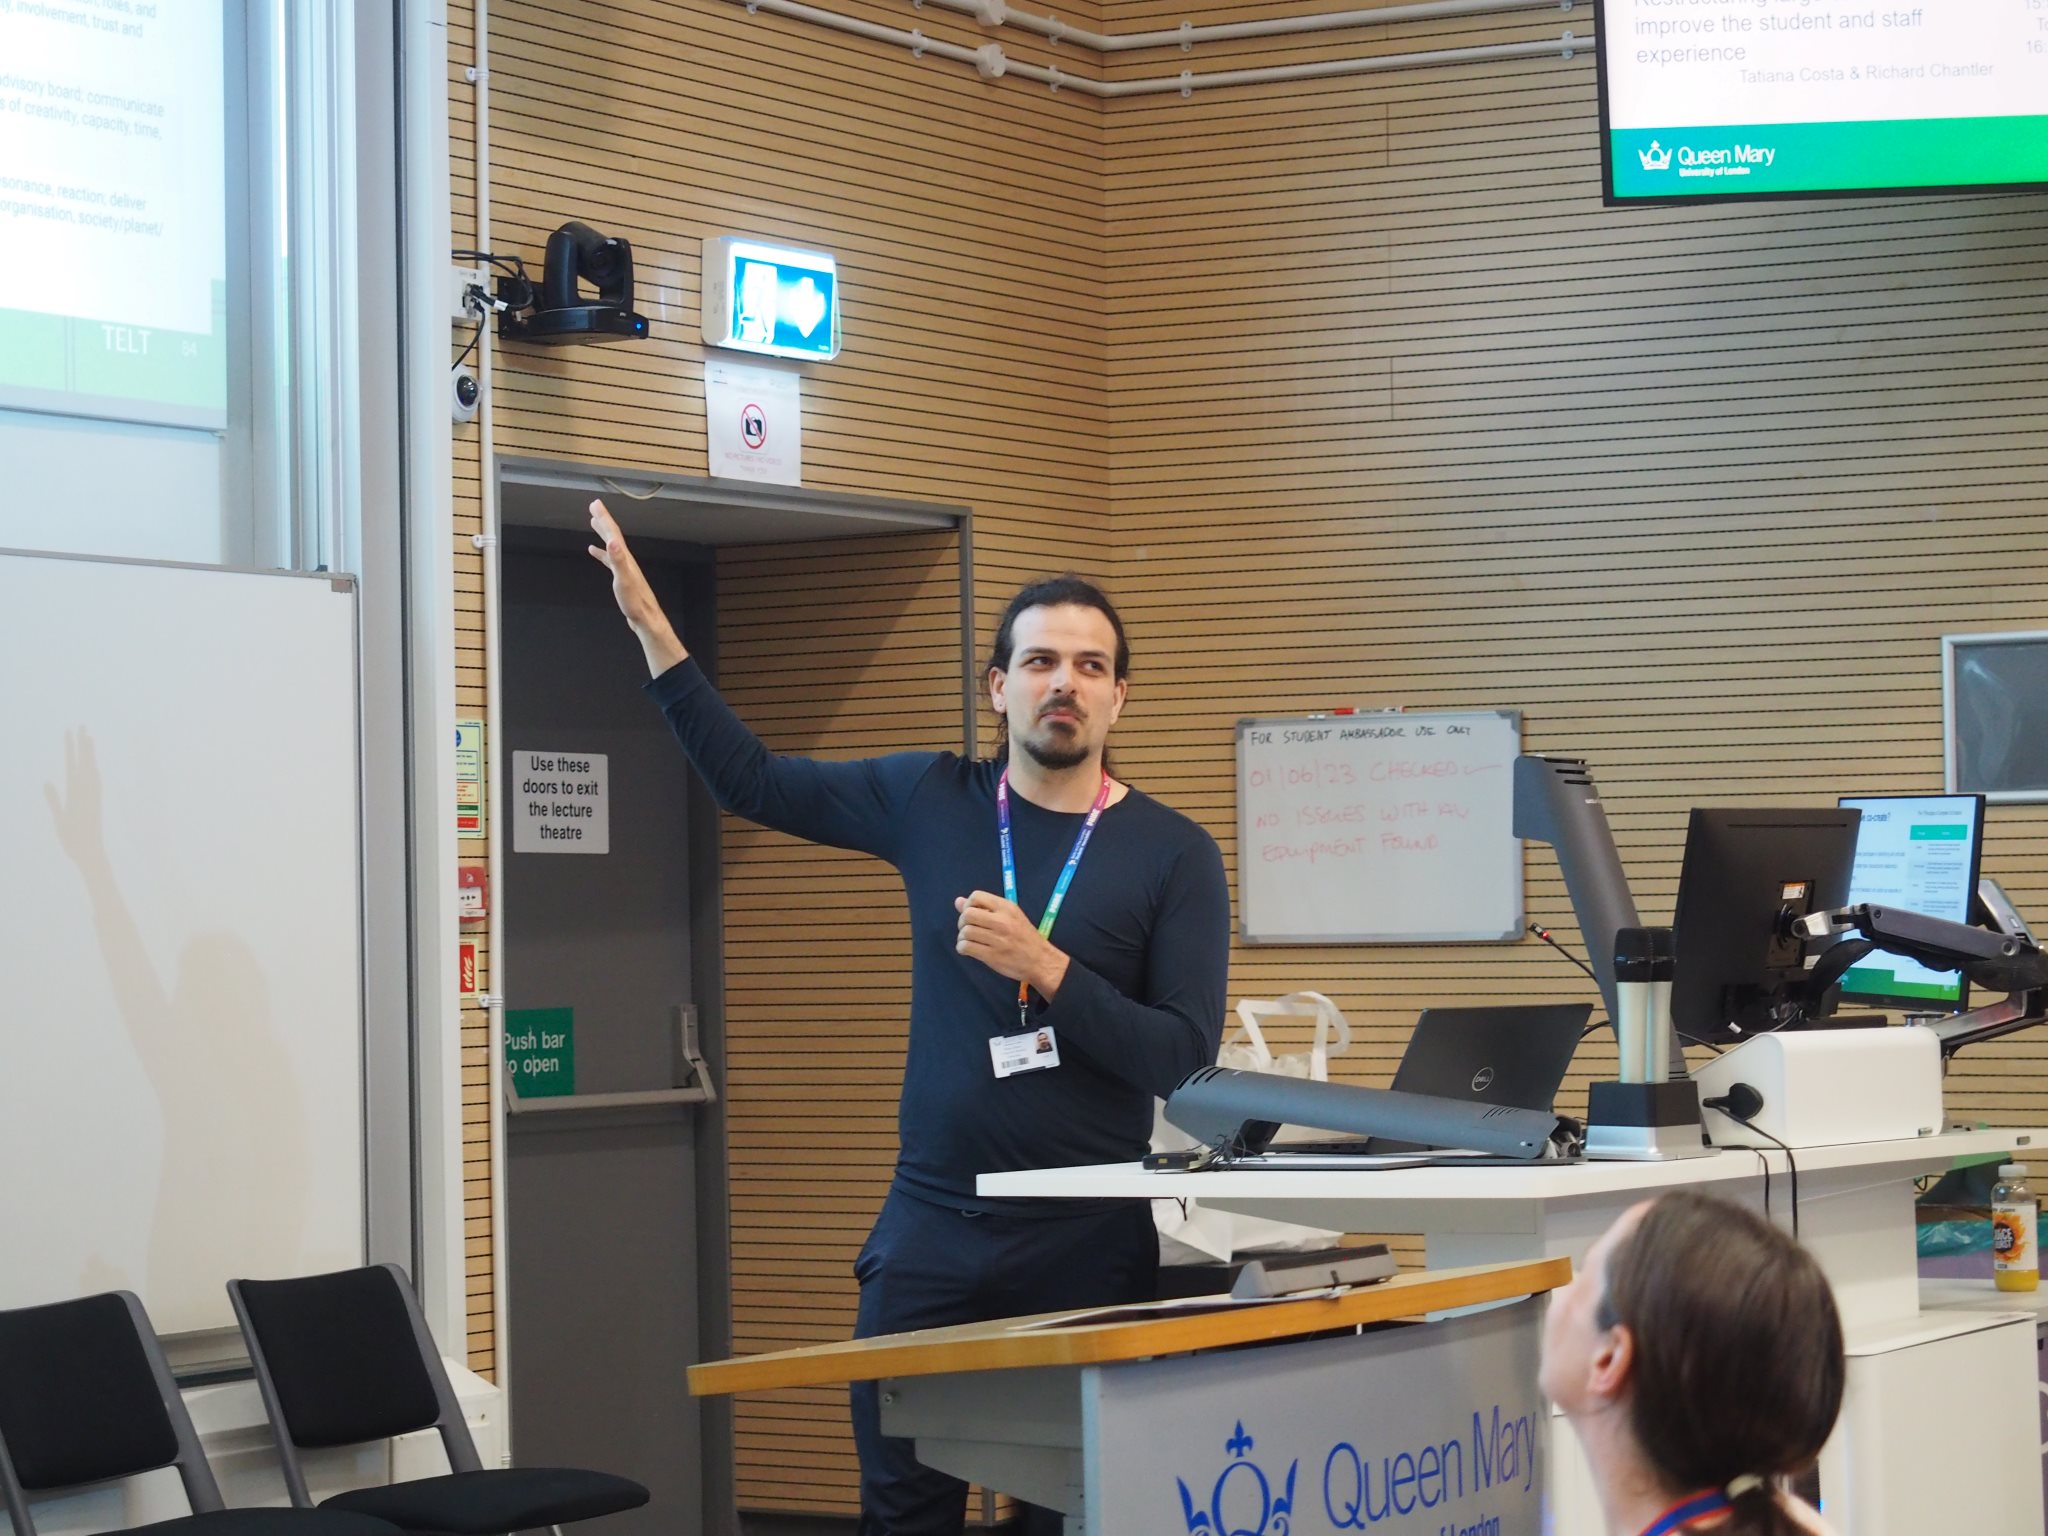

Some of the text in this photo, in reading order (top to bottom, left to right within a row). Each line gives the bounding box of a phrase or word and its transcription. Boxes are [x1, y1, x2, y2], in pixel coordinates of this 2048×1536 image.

[16, 0, 89, 28] involvement,
[92, 14, 118, 33] trust
[122, 23, 143, 38] and
[136, 4, 157, 18] and
[1635, 9, 1923, 38] improve the student and staff
[1636, 45, 1746, 67] experience
[1740, 62, 1994, 84] Tatiana Costa & Richard Chantler
[87, 91, 164, 117] communicate
[9, 97, 21, 112] of
[24, 102, 79, 126] creativity,
[82, 113, 131, 136] capacity,
[134, 121, 162, 141] time,
[1678, 143, 1776, 167] Queen Mary
[1715, 166, 1724, 176] of
[0, 175, 54, 198] sonance,
[109, 191, 146, 211] deliver
[101, 324, 152, 355] TELT
[1251, 731, 1273, 746] FOR
[1283, 729, 1333, 744] STUDENT
[1415, 726, 1437, 737] USE
[531, 755, 590, 773] Use these
[1370, 760, 1458, 782] CHECKED
[523, 779, 599, 796] doors to exit
[529, 801, 593, 818] the lecture
[540, 824, 583, 840] theatre
[1256, 813, 1280, 829] NO
[504, 1031, 566, 1050] Push bar
[523, 1057, 559, 1077] open
[1324, 1404, 1536, 1530] Queen Mary
